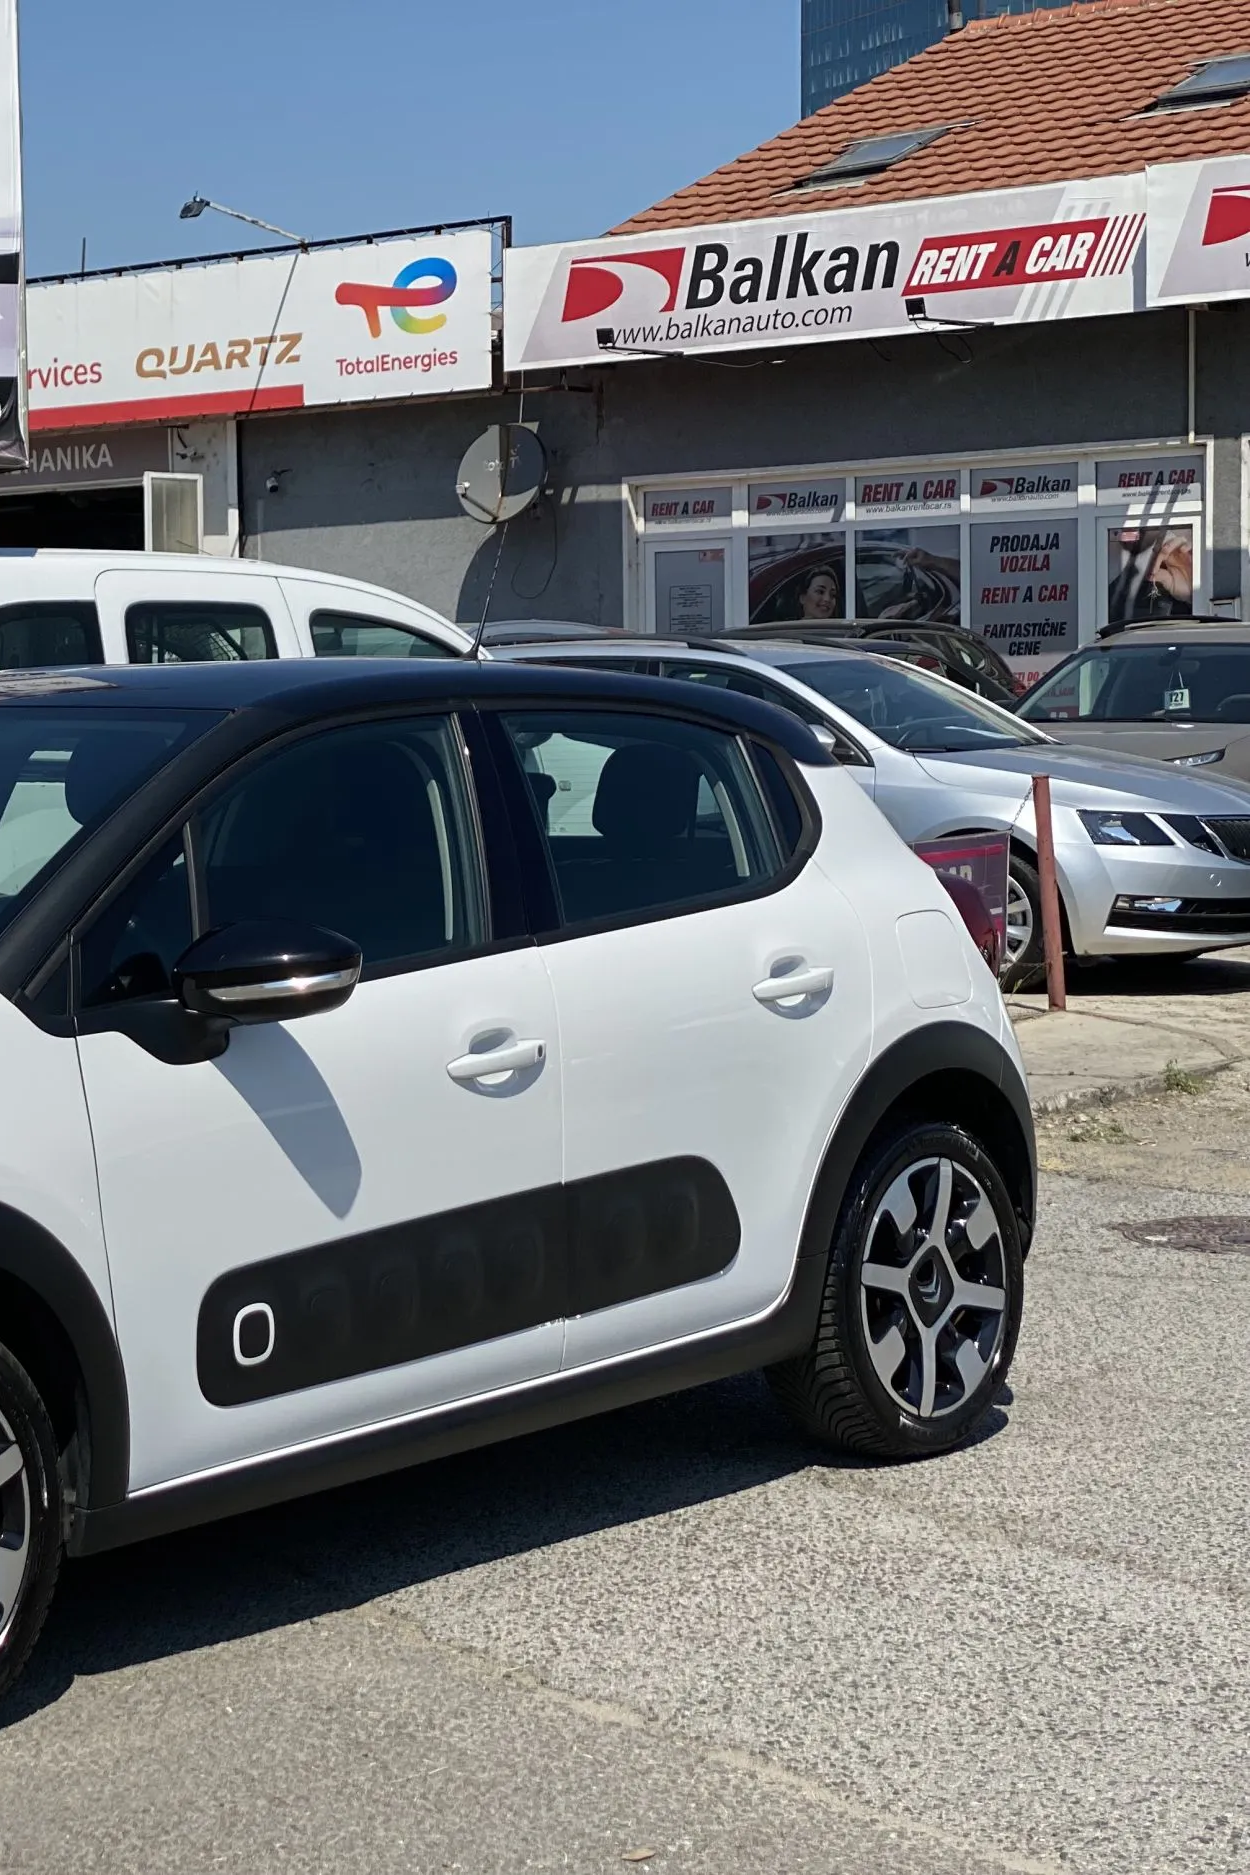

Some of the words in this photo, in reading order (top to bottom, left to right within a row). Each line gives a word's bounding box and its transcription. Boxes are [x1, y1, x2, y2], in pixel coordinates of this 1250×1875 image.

[686, 232, 901, 310] Balkan
[911, 242, 995, 289] RENT
[994, 239, 1020, 279] A
[1023, 229, 1097, 275] CAR
[134, 332, 304, 381] QUARTZ
[336, 348, 459, 379] TotalEnergies
[1014, 476, 1071, 495] Balkan
[1118, 471, 1153, 488] RENT
[1154, 470, 1164, 486] A
[1168, 468, 1196, 485] CAR
[787, 491, 839, 509] Balkan
[861, 482, 904, 504] RENT
[906, 480, 918, 501] A
[922, 478, 957, 500] CAR
[651, 502, 679, 517] RENT
[680, 501, 689, 515] A
[692, 500, 715, 515] CAR
[989, 532, 1060, 553] PRODAJA
[1000, 554, 1051, 573] VOZILA
[981, 585, 1020, 604] RENT
[1022, 585, 1033, 603] A
[1037, 583, 1069, 602] CAR
[983, 618, 1067, 639] FANTASTIČNE
[1008, 640, 1042, 657] CENE
